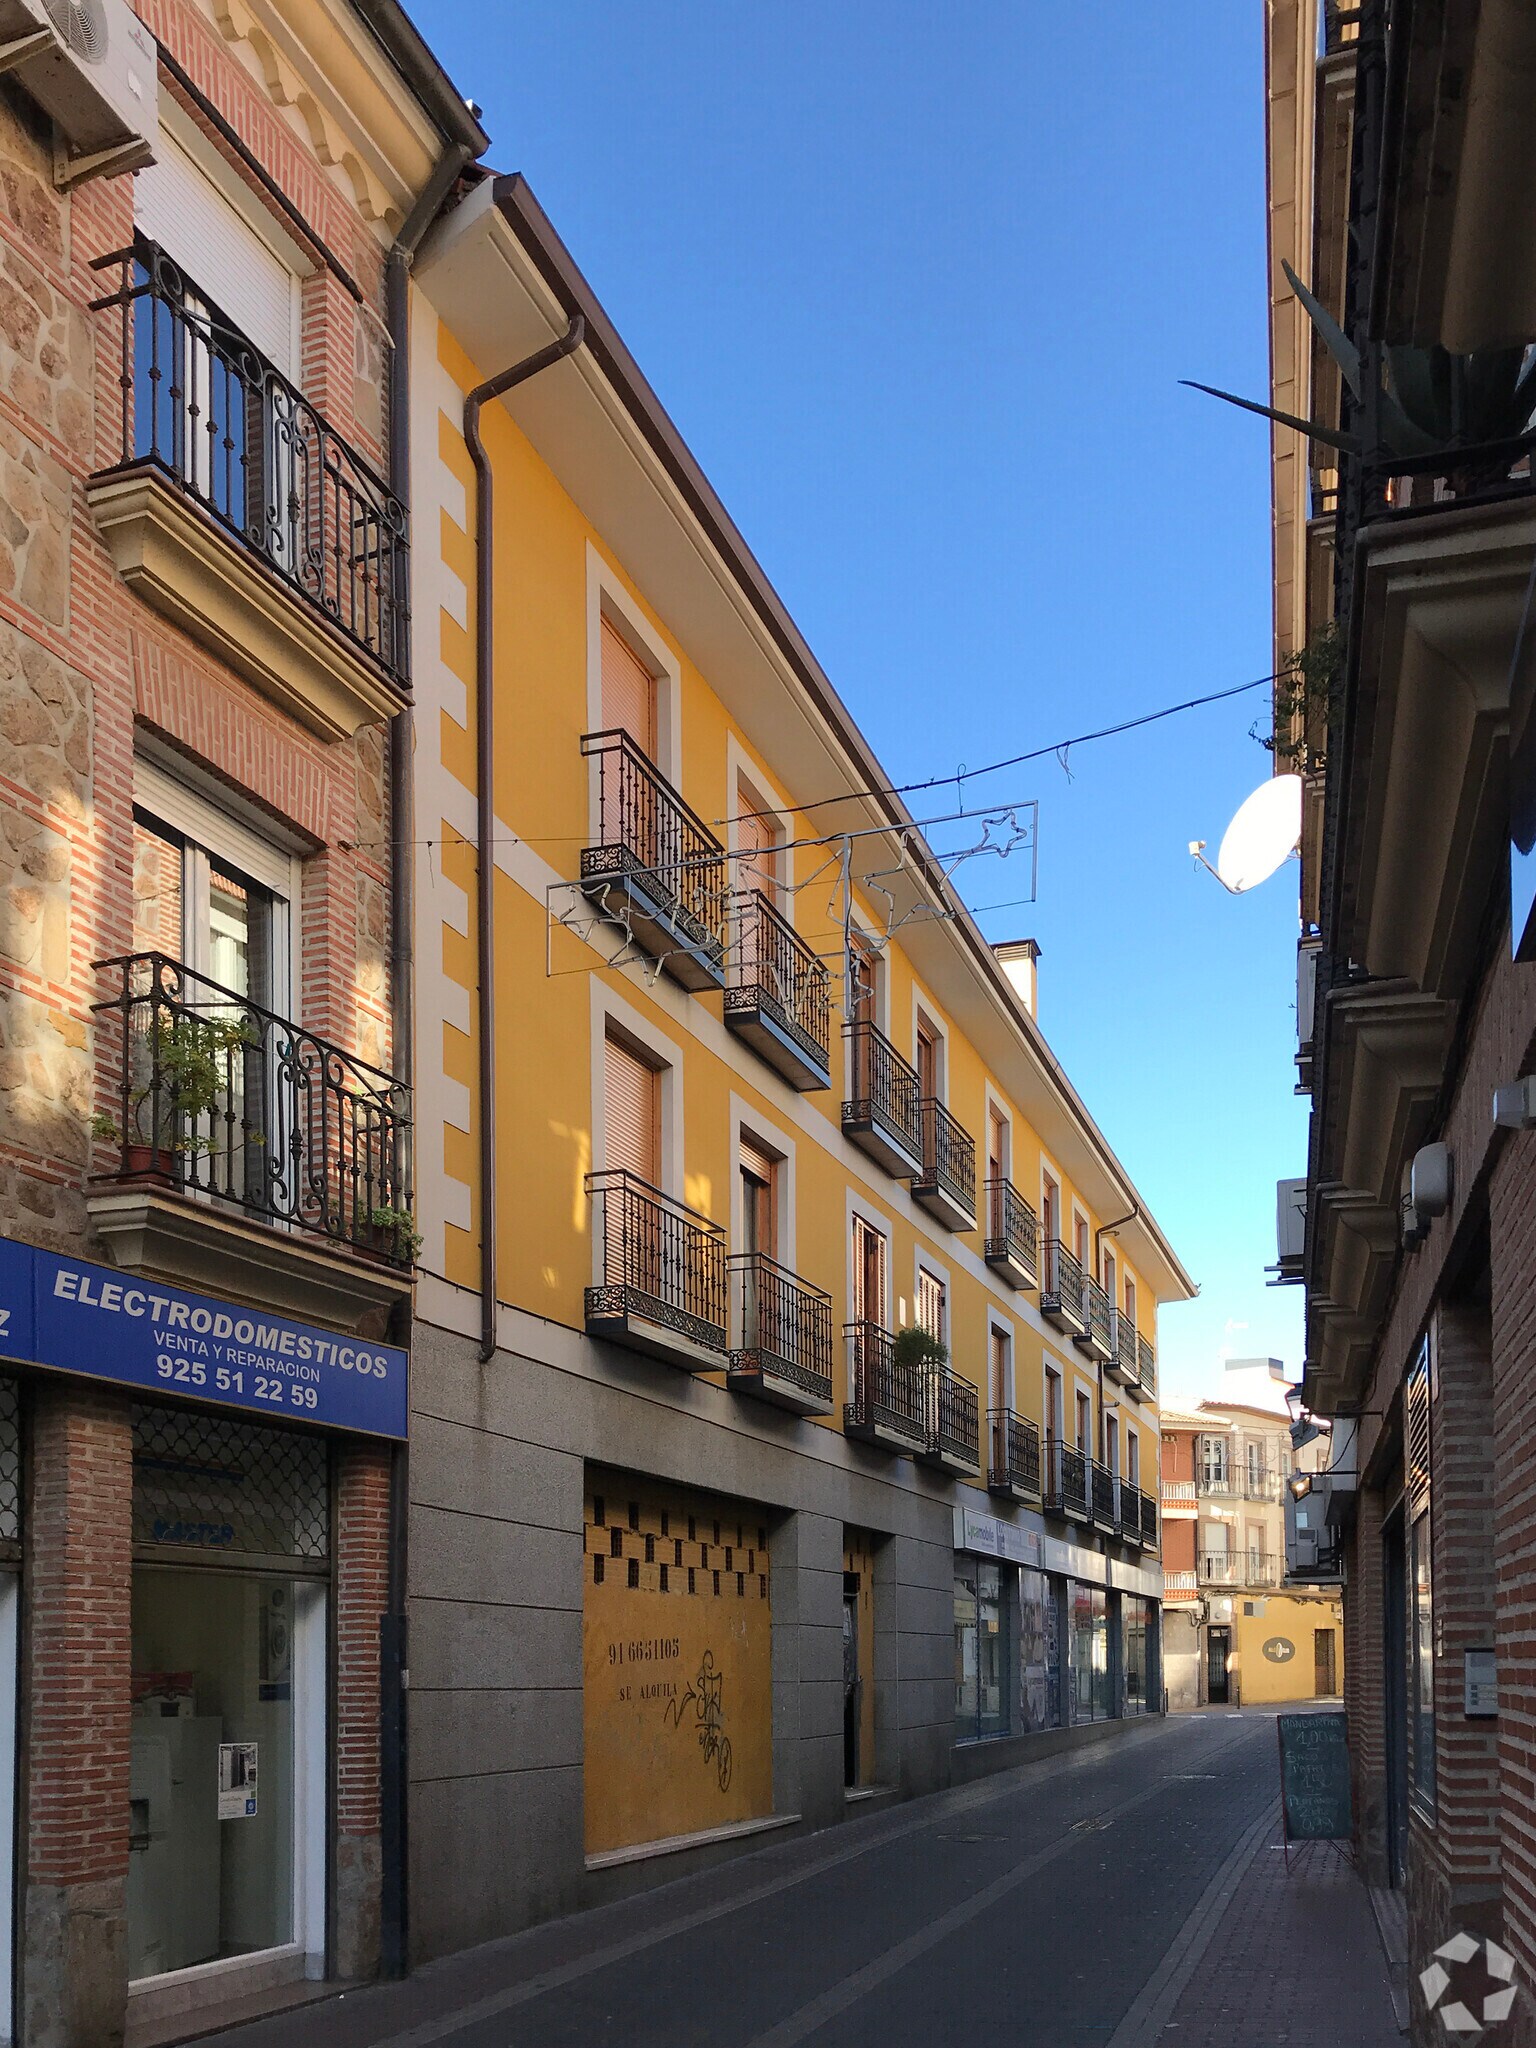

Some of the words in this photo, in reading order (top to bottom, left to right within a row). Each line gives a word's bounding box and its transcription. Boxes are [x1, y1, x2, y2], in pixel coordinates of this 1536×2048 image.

[53, 1269, 389, 1379] ELECTRODOMESTICOS
[154, 1329, 209, 1356] VENTA
[213, 1343, 223, 1360] Y
[226, 1348, 321, 1383] REPARACION
[157, 1354, 207, 1386] 925
[215, 1368, 244, 1394] 51
[254, 1376, 283, 1403] 22
[291, 1384, 318, 1410] 59
[609, 1642, 624, 1666] 91
[619, 1686, 632, 1701] SE
[640, 1682, 678, 1699] ALQUILA
